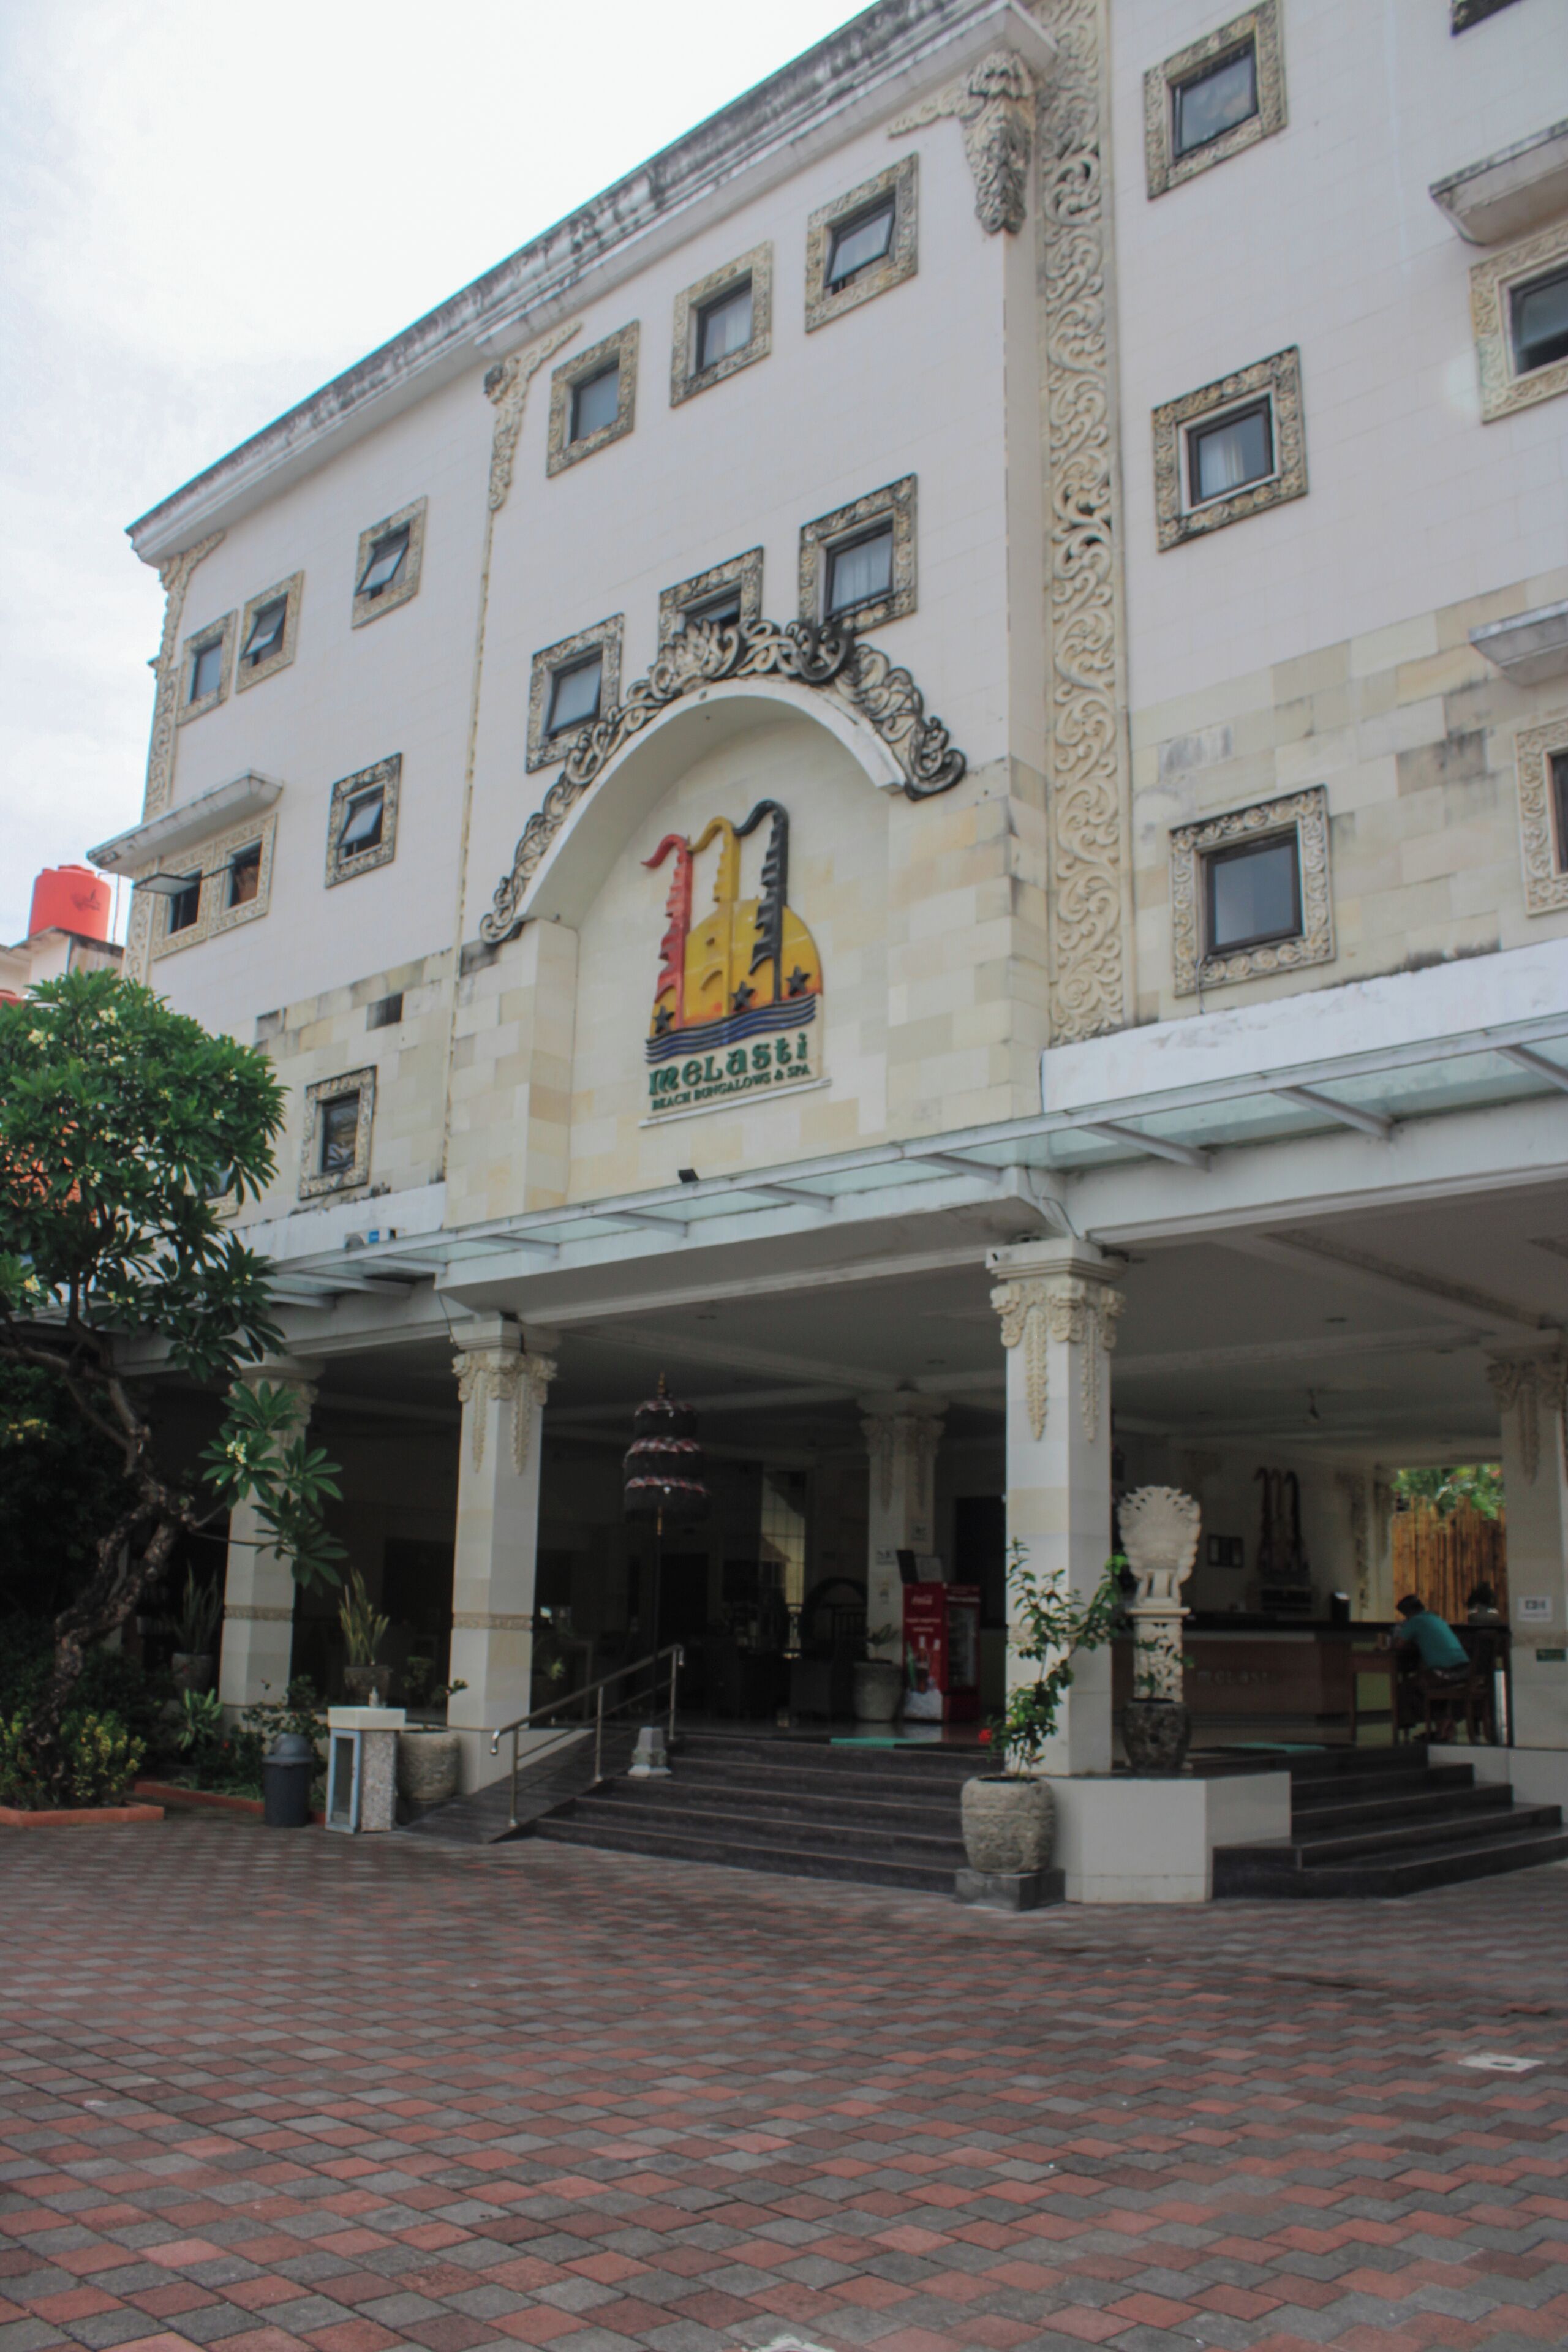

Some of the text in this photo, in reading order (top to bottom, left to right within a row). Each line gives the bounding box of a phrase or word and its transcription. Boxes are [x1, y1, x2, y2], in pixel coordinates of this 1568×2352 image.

[652, 1091, 691, 1111] BEACH
[774, 1069, 784, 1081] &
[787, 1063, 811, 1077] SPA
